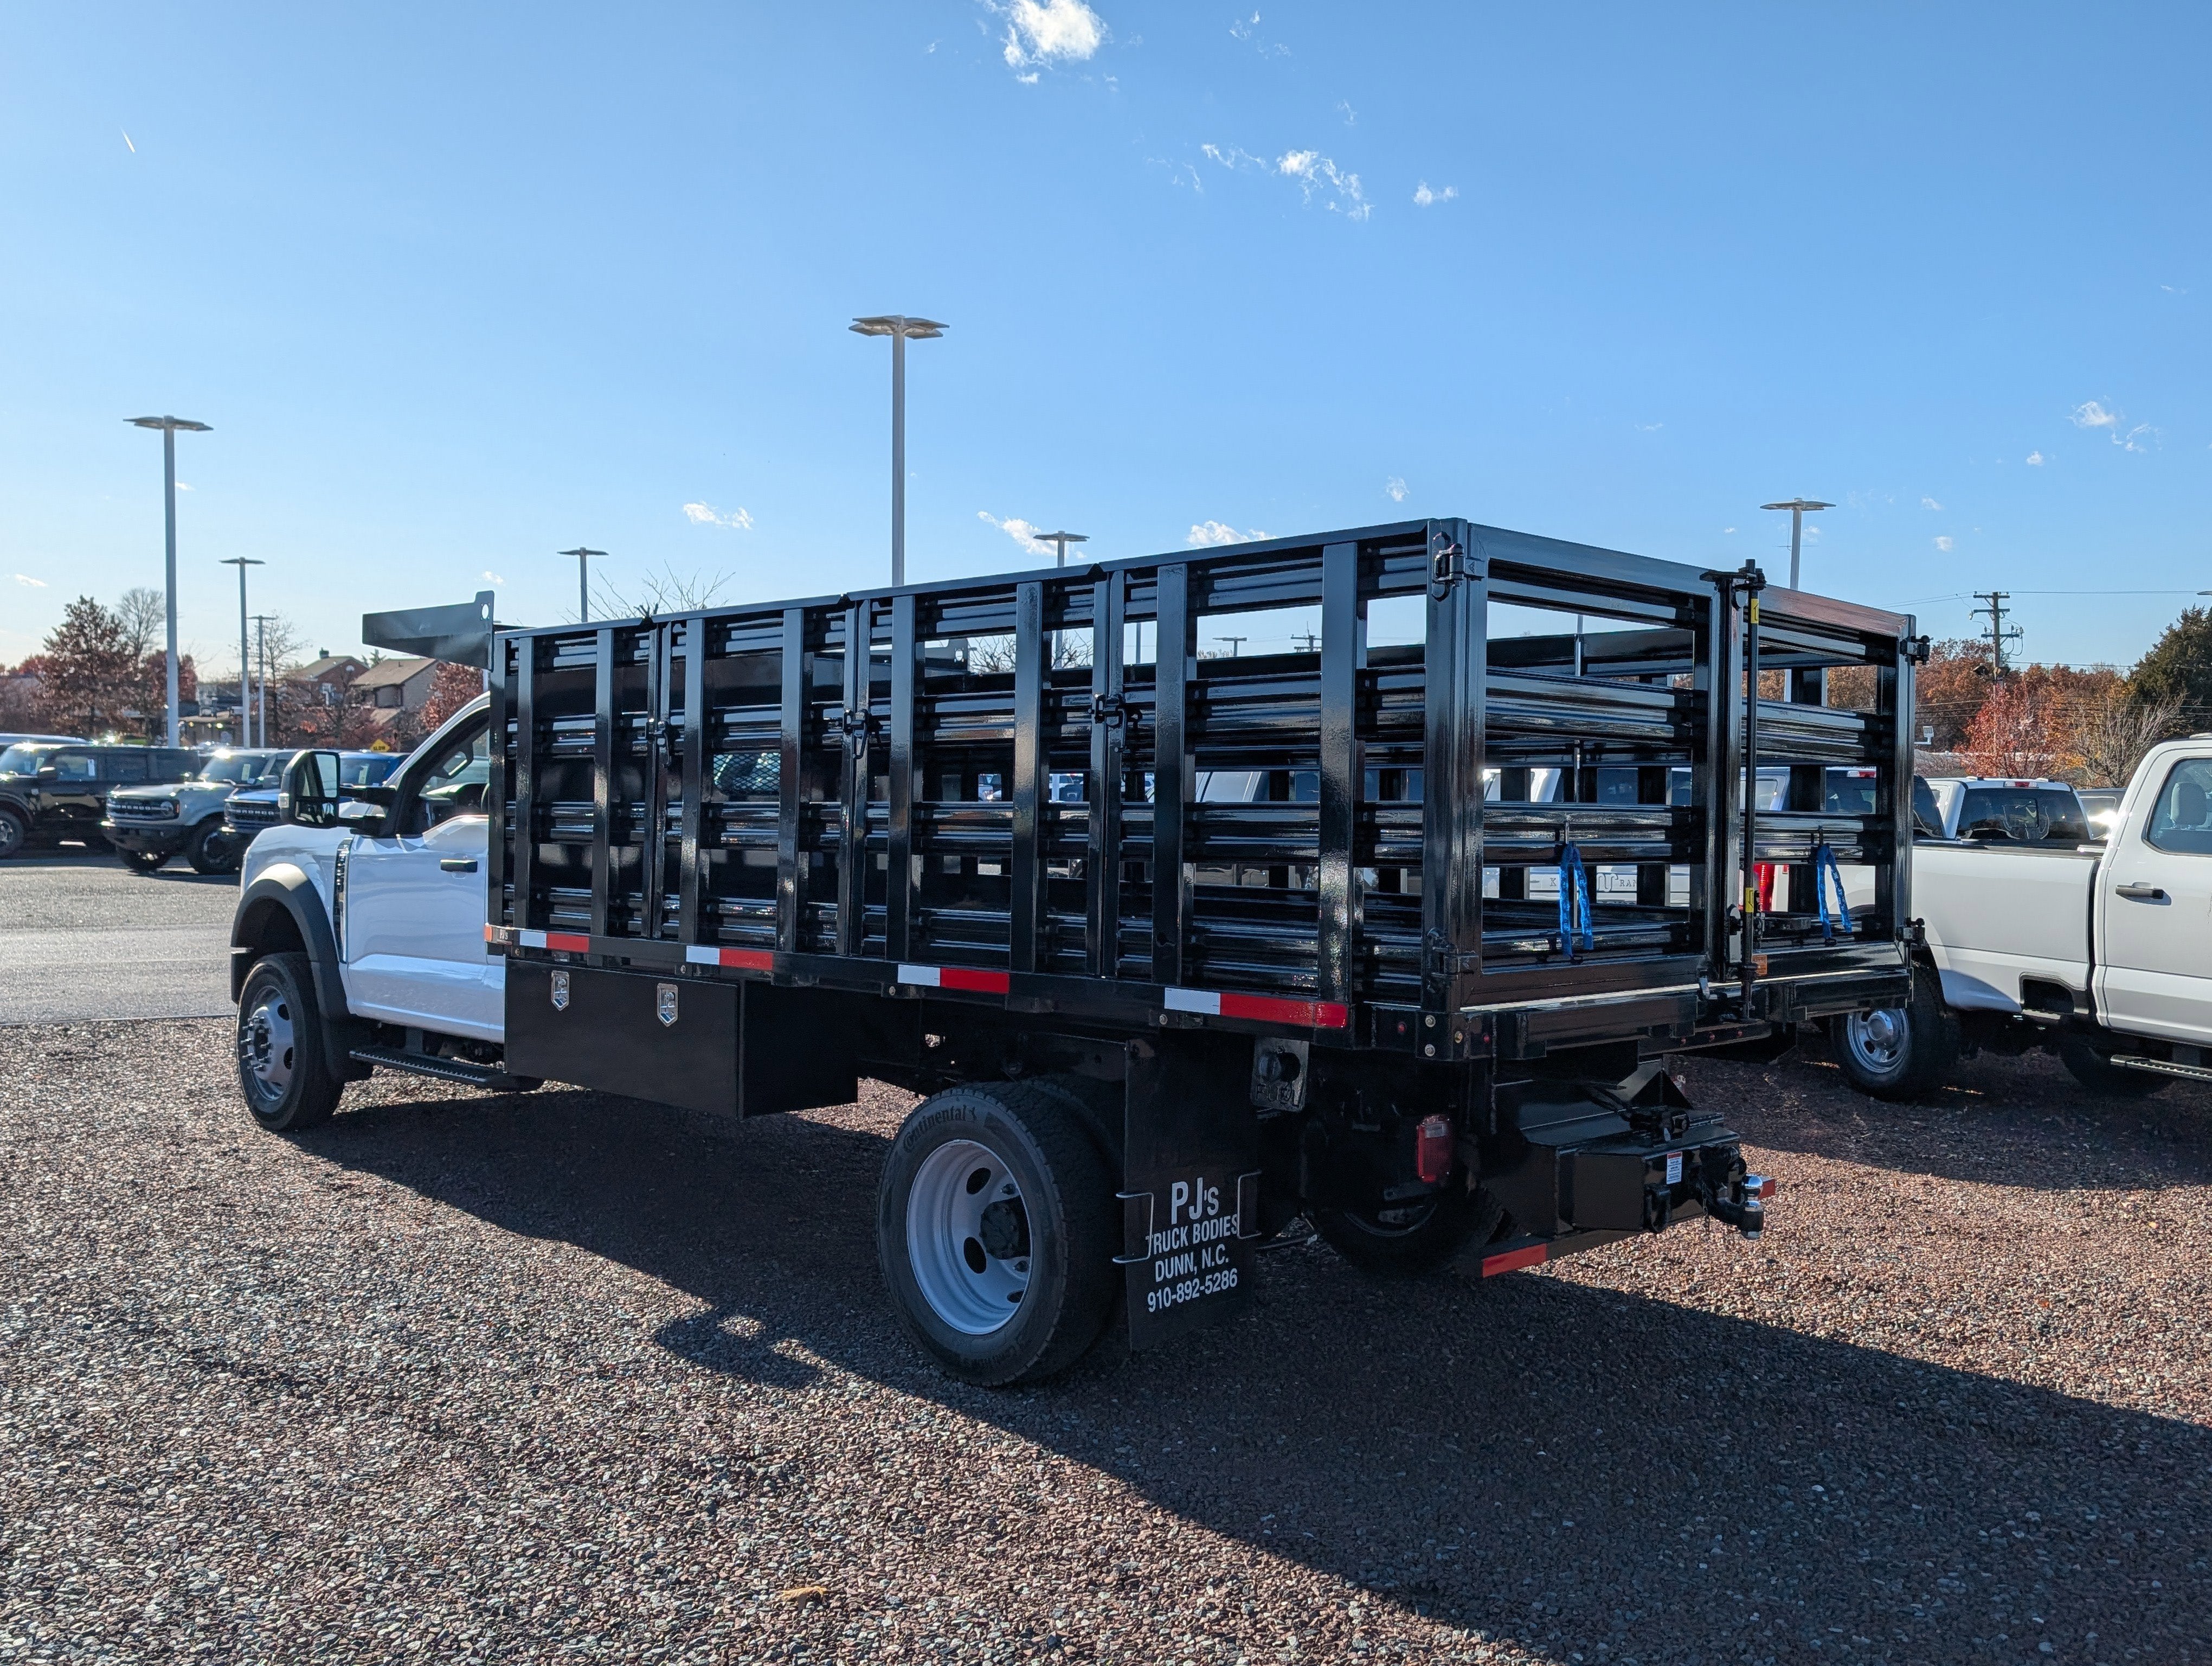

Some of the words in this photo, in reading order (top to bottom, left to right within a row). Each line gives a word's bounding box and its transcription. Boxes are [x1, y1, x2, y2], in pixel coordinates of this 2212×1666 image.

[1619, 879, 1637, 887] RAN
[903, 1104, 967, 1152] Continental
[1171, 1177, 1219, 1225] PJ's
[1193, 1214, 1238, 1244] BODIES
[1155, 1252, 1197, 1283] DUNN,
[1201, 1244, 1229, 1270] N.C.
[1147, 1268, 1238, 1312] 910-892-5286
